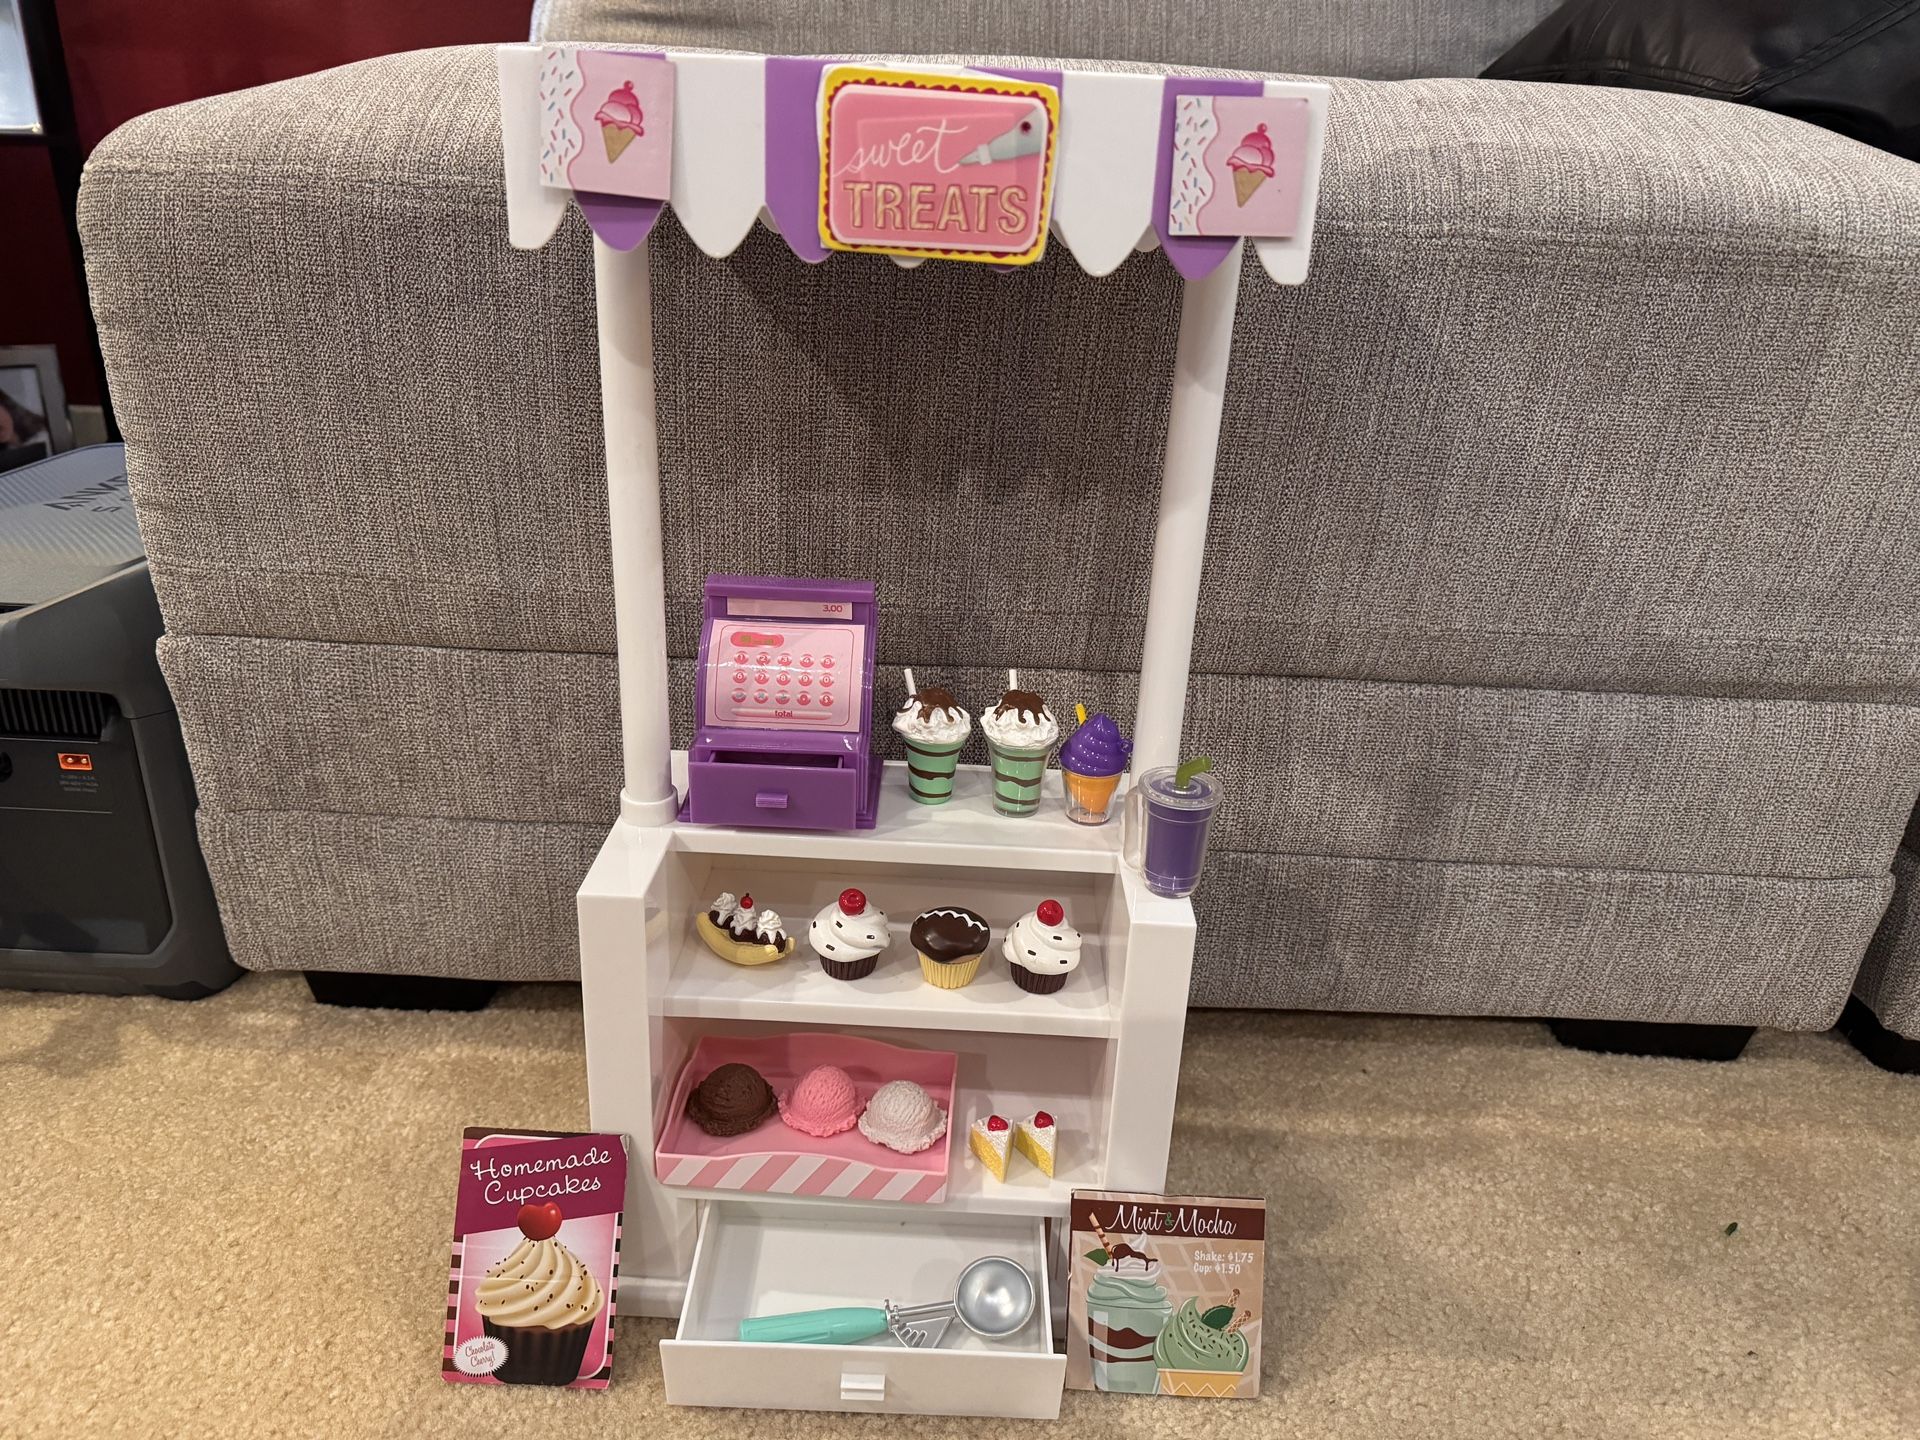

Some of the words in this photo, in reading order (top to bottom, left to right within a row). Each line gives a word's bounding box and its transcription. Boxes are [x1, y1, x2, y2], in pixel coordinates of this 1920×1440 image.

[832, 119, 969, 178] sweet
[843, 180, 1029, 234] TREATS
[822, 604, 843, 613] 3.00
[774, 710, 793, 718] total
[469, 1147, 612, 1181] Homemade
[484, 1175, 602, 1206] Cupcakes
[1104, 1204, 1168, 1234] Mint
[1165, 1207, 1238, 1237] Mocha
[1194, 1250, 1225, 1262] Shake:
[1227, 1251, 1255, 1264] $1.75
[1193, 1262, 1212, 1276] Cup:
[1214, 1262, 1241, 1275] $1.50
[465, 1341, 496, 1357] Chocolate
[470, 1350, 496, 1368] Cherry!
